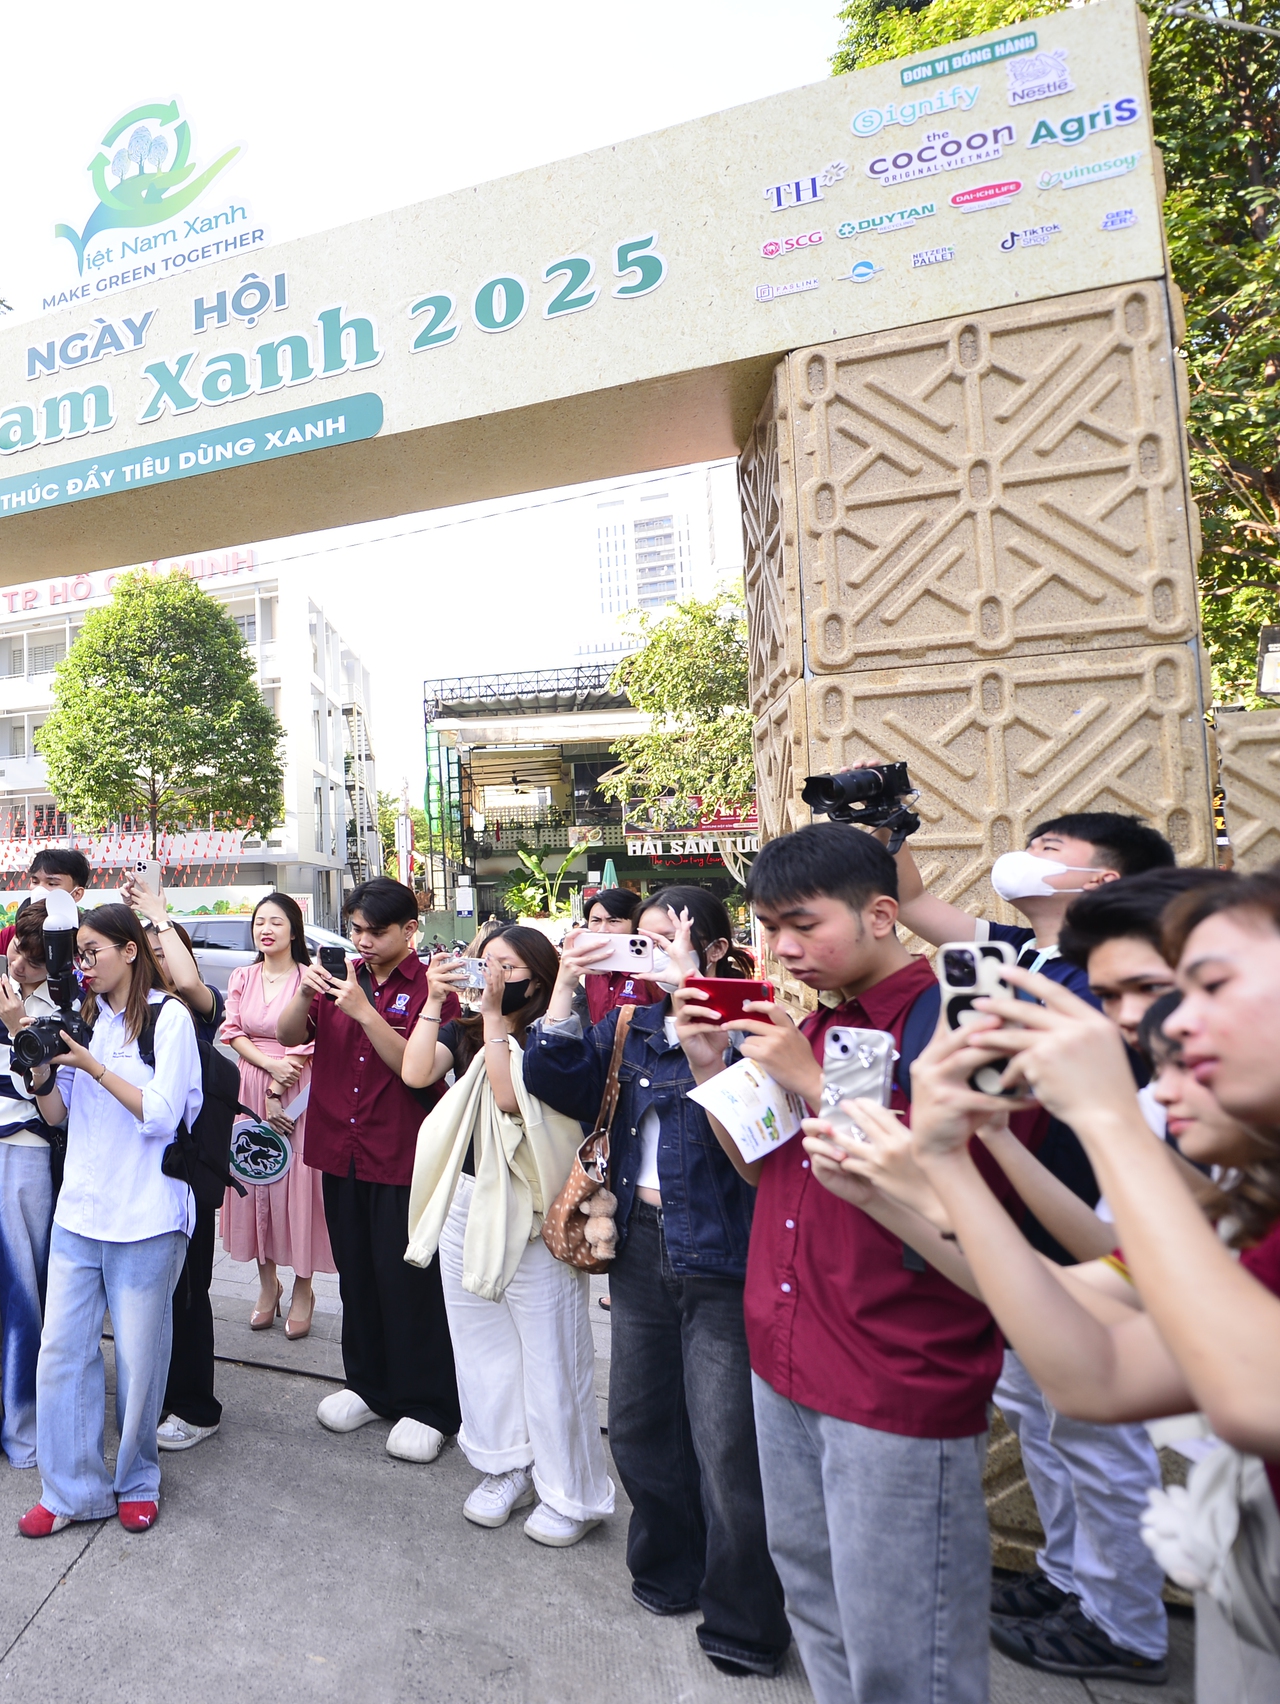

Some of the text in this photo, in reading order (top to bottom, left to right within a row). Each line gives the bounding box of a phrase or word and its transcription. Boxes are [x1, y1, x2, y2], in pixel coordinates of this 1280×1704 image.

[903, 35, 1036, 84] ĐƠN VỊ ĐỒNG HÀNH
[1031, 98, 1138, 145] AgriS
[869, 125, 1014, 175] cocoon
[927, 131, 949, 143] the
[1063, 155, 1137, 181] vinasoy
[766, 176, 820, 207] TH
[955, 182, 1017, 203] DAI-ICHI LIFE
[858, 203, 935, 231] DUYTAN
[879, 219, 914, 232] RECYCLING
[1106, 208, 1134, 220] GEN
[120, 228, 178, 259] Nam
[184, 205, 248, 239] Xanh
[784, 231, 823, 250] SCG
[1022, 223, 1061, 237] TikTok
[1022, 234, 1049, 246] Shop
[42, 229, 265, 310] MAKE GREEN TOGETHER
[913, 251, 955, 267] PALLET
[776, 278, 819, 292] FASLINK
[27, 272, 286, 378] NGÀY HỘI
[139, 306, 380, 419] Xanh
[411, 235, 665, 350] 2025
[1, 415, 346, 510] THÚC ĐẨY TIÊU DÙNG XANH
[49, 572, 92, 605] HỒ
[628, 836, 663, 856] HẢI
[670, 835, 714, 855] SẢN
[650, 854, 663, 867] The
